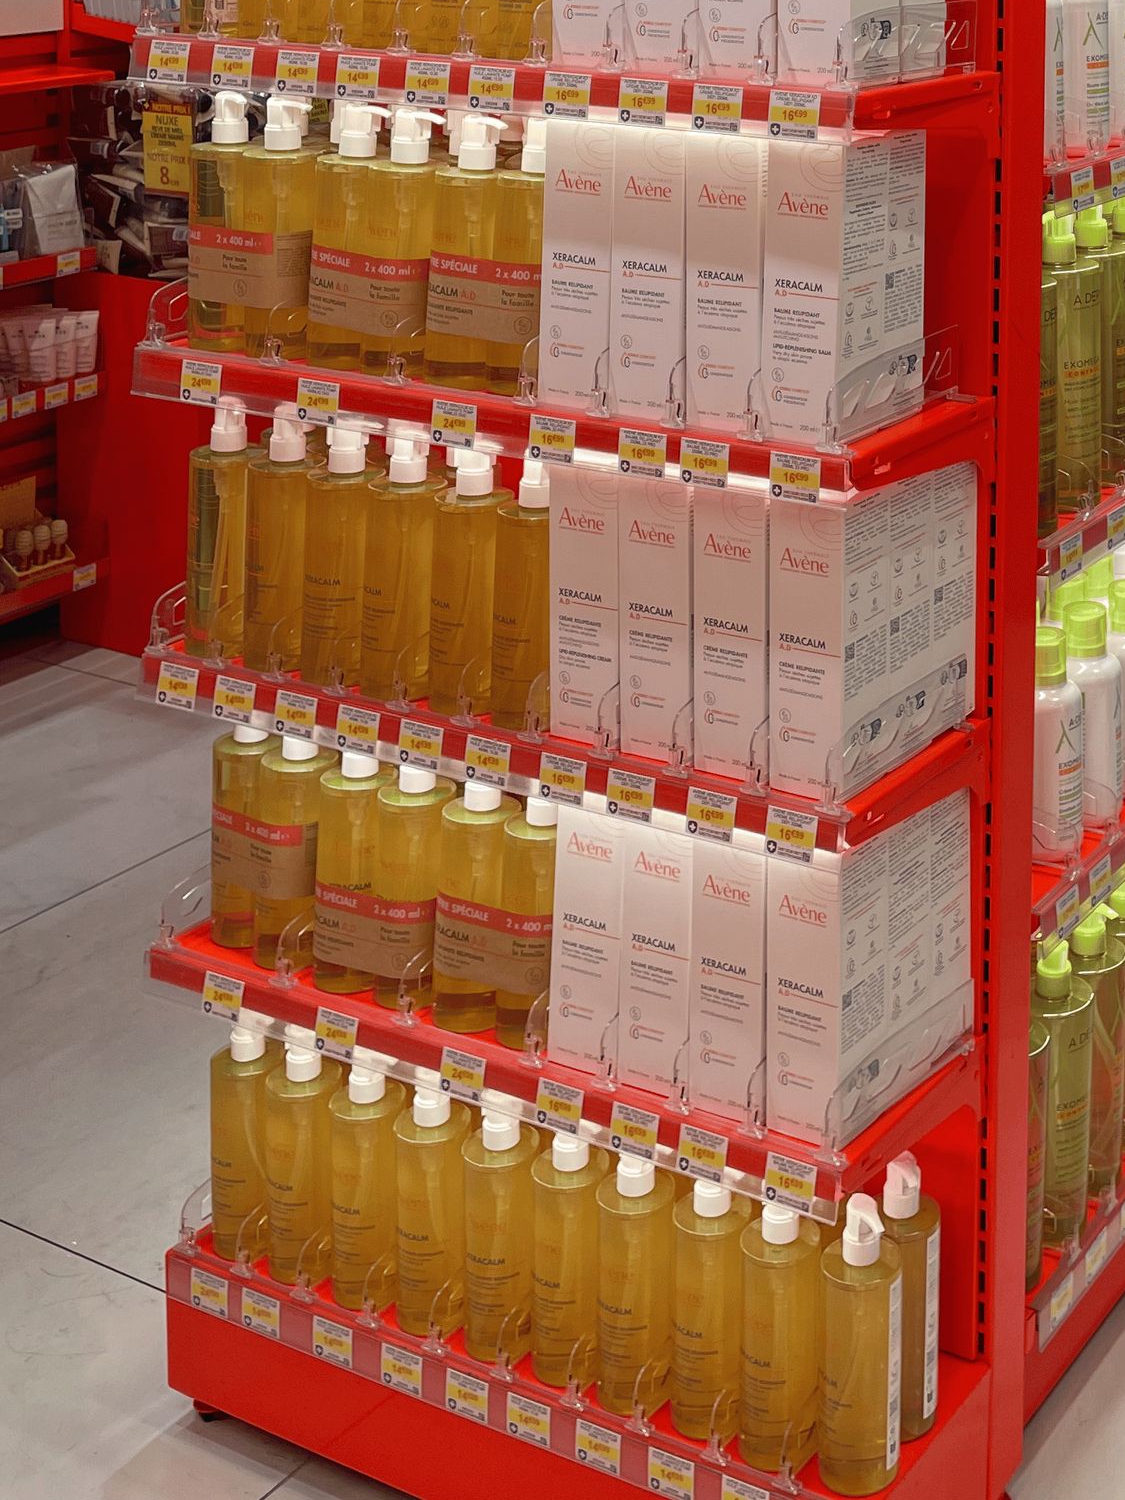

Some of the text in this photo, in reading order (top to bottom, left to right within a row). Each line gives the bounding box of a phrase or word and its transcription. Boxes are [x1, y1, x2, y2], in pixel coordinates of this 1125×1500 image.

[156, 115, 178, 126] NUXE
[782, 108, 808, 122] 16€99
[555, 169, 601, 193] Avène
[625, 176, 672, 199] Avène
[698, 184, 747, 207] Avène
[778, 192, 829, 216] Avène
[216, 234, 221, 243] 2
[229, 236, 242, 246] 400
[319, 252, 350, 267] SPÉCIALE
[552, 252, 596, 266] XERACALM
[622, 260, 667, 273] XERACALM
[364, 262, 369, 272] 2
[378, 265, 395, 275] 400
[399, 265, 410, 276] ml
[440, 258, 478, 274] SPÉCIALE
[496, 268, 501, 278] 2
[511, 270, 530, 280] 400
[697, 270, 744, 282] XERACALM
[774, 279, 823, 293] XERACALM
[559, 507, 605, 532] Avène
[629, 520, 675, 545] Avène
[704, 534, 751, 559] Avène
[780, 548, 829, 574] Avène
[559, 587, 602, 604] XERACALM
[629, 602, 673, 618] XERACALM
[704, 617, 749, 634] XERACALM
[779, 633, 826, 650] XERACALM
[567, 832, 613, 859] Avène
[635, 851, 681, 878] Avène
[703, 874, 751, 903] Avène
[779, 894, 827, 924] Avène
[506, 918, 512, 928] 2
[521, 922, 540, 931] 400
[563, 912, 607, 932] XERACALM
[631, 933, 676, 952] XERACALM
[701, 957, 747, 976] XERACALM
[778, 977, 824, 998] XERACALM
